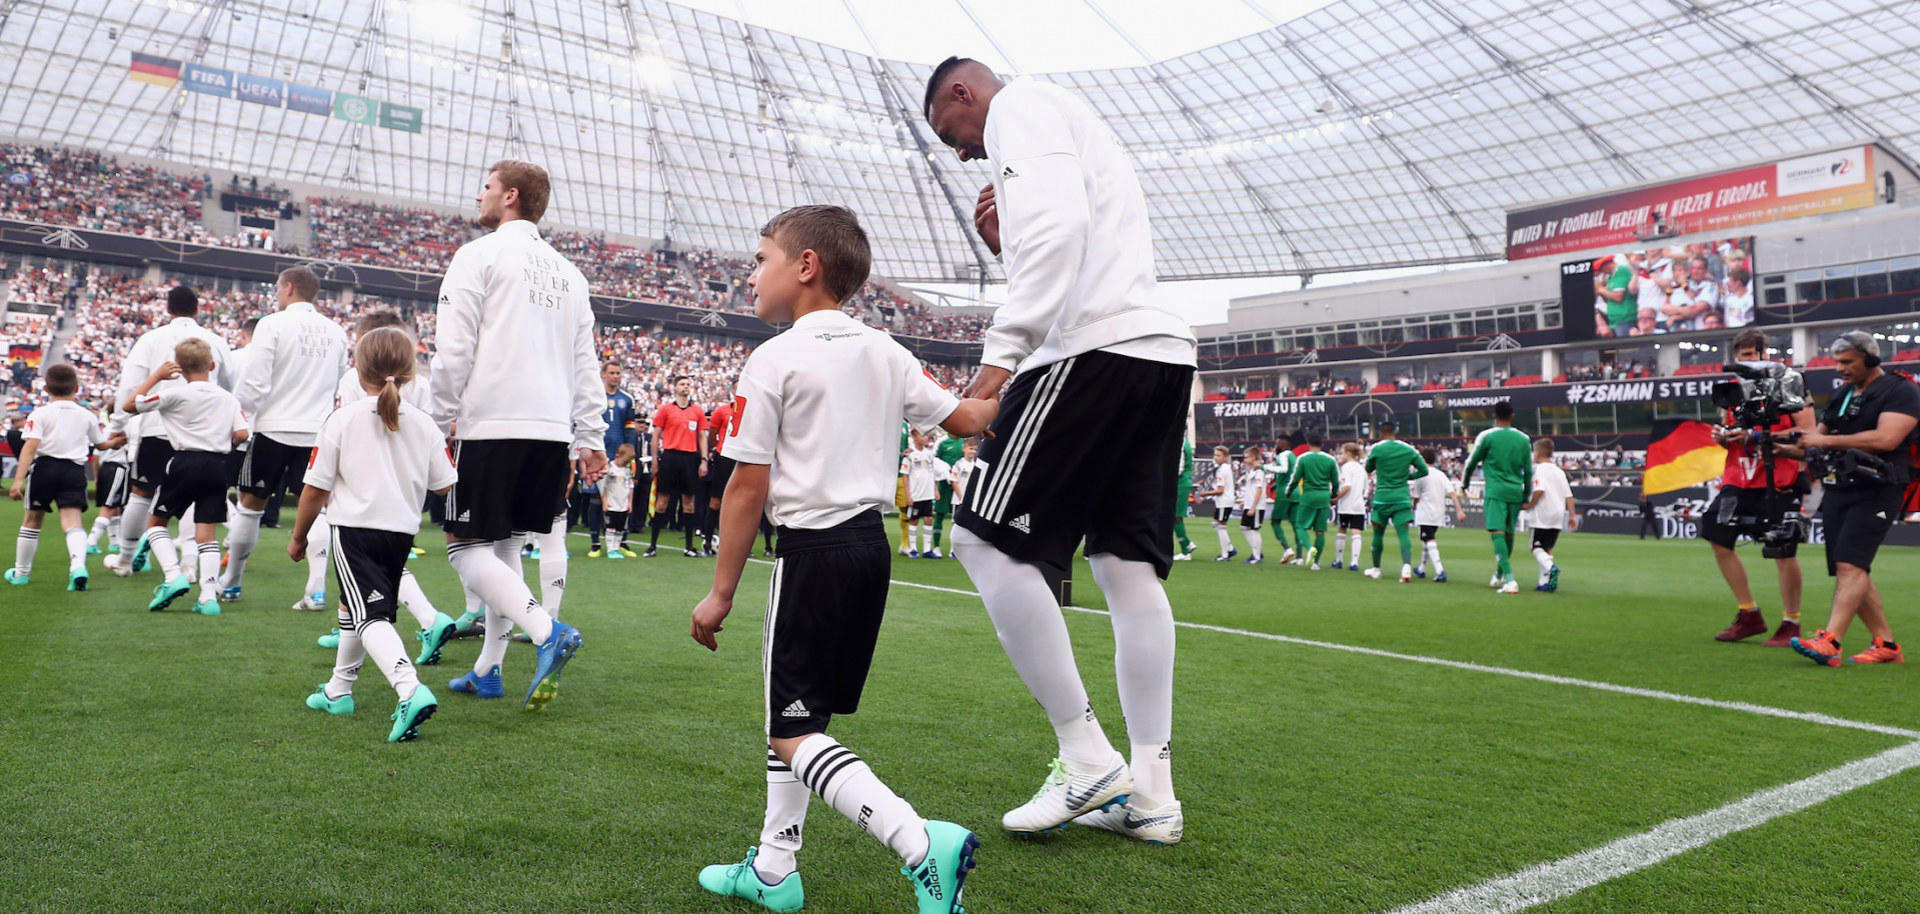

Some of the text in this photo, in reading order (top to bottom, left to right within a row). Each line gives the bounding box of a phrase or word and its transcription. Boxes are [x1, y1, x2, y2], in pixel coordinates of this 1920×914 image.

[190, 69, 227, 88] FIFA
[240, 81, 278, 99] UEFA
[1511, 223, 1543, 246] UNITED
[1544, 220, 1559, 239] BY
[1559, 209, 1608, 236] FOOTBALL.
[1608, 205, 1652, 231] VEREINT
[1670, 191, 1713, 218] HERZEN
[1715, 180, 1769, 208] EUROPAS.
[526, 252, 560, 272] BEST
[1563, 262, 1592, 275] 19:27
[523, 267, 570, 293] NEVER
[529, 289, 562, 310] REST
[300, 324, 327, 334] BEST
[301, 347, 327, 358] REST
[1566, 381, 1654, 404] #ZSMMN
[1213, 401, 1325, 417] #ZSMMN JUBELN
[1418, 399, 1434, 409] DIE
[609, 409, 614, 421] 1
[1662, 516, 1698, 539] Die
[781, 710, 811, 718] adidas
[928, 858, 944, 901] adidas
